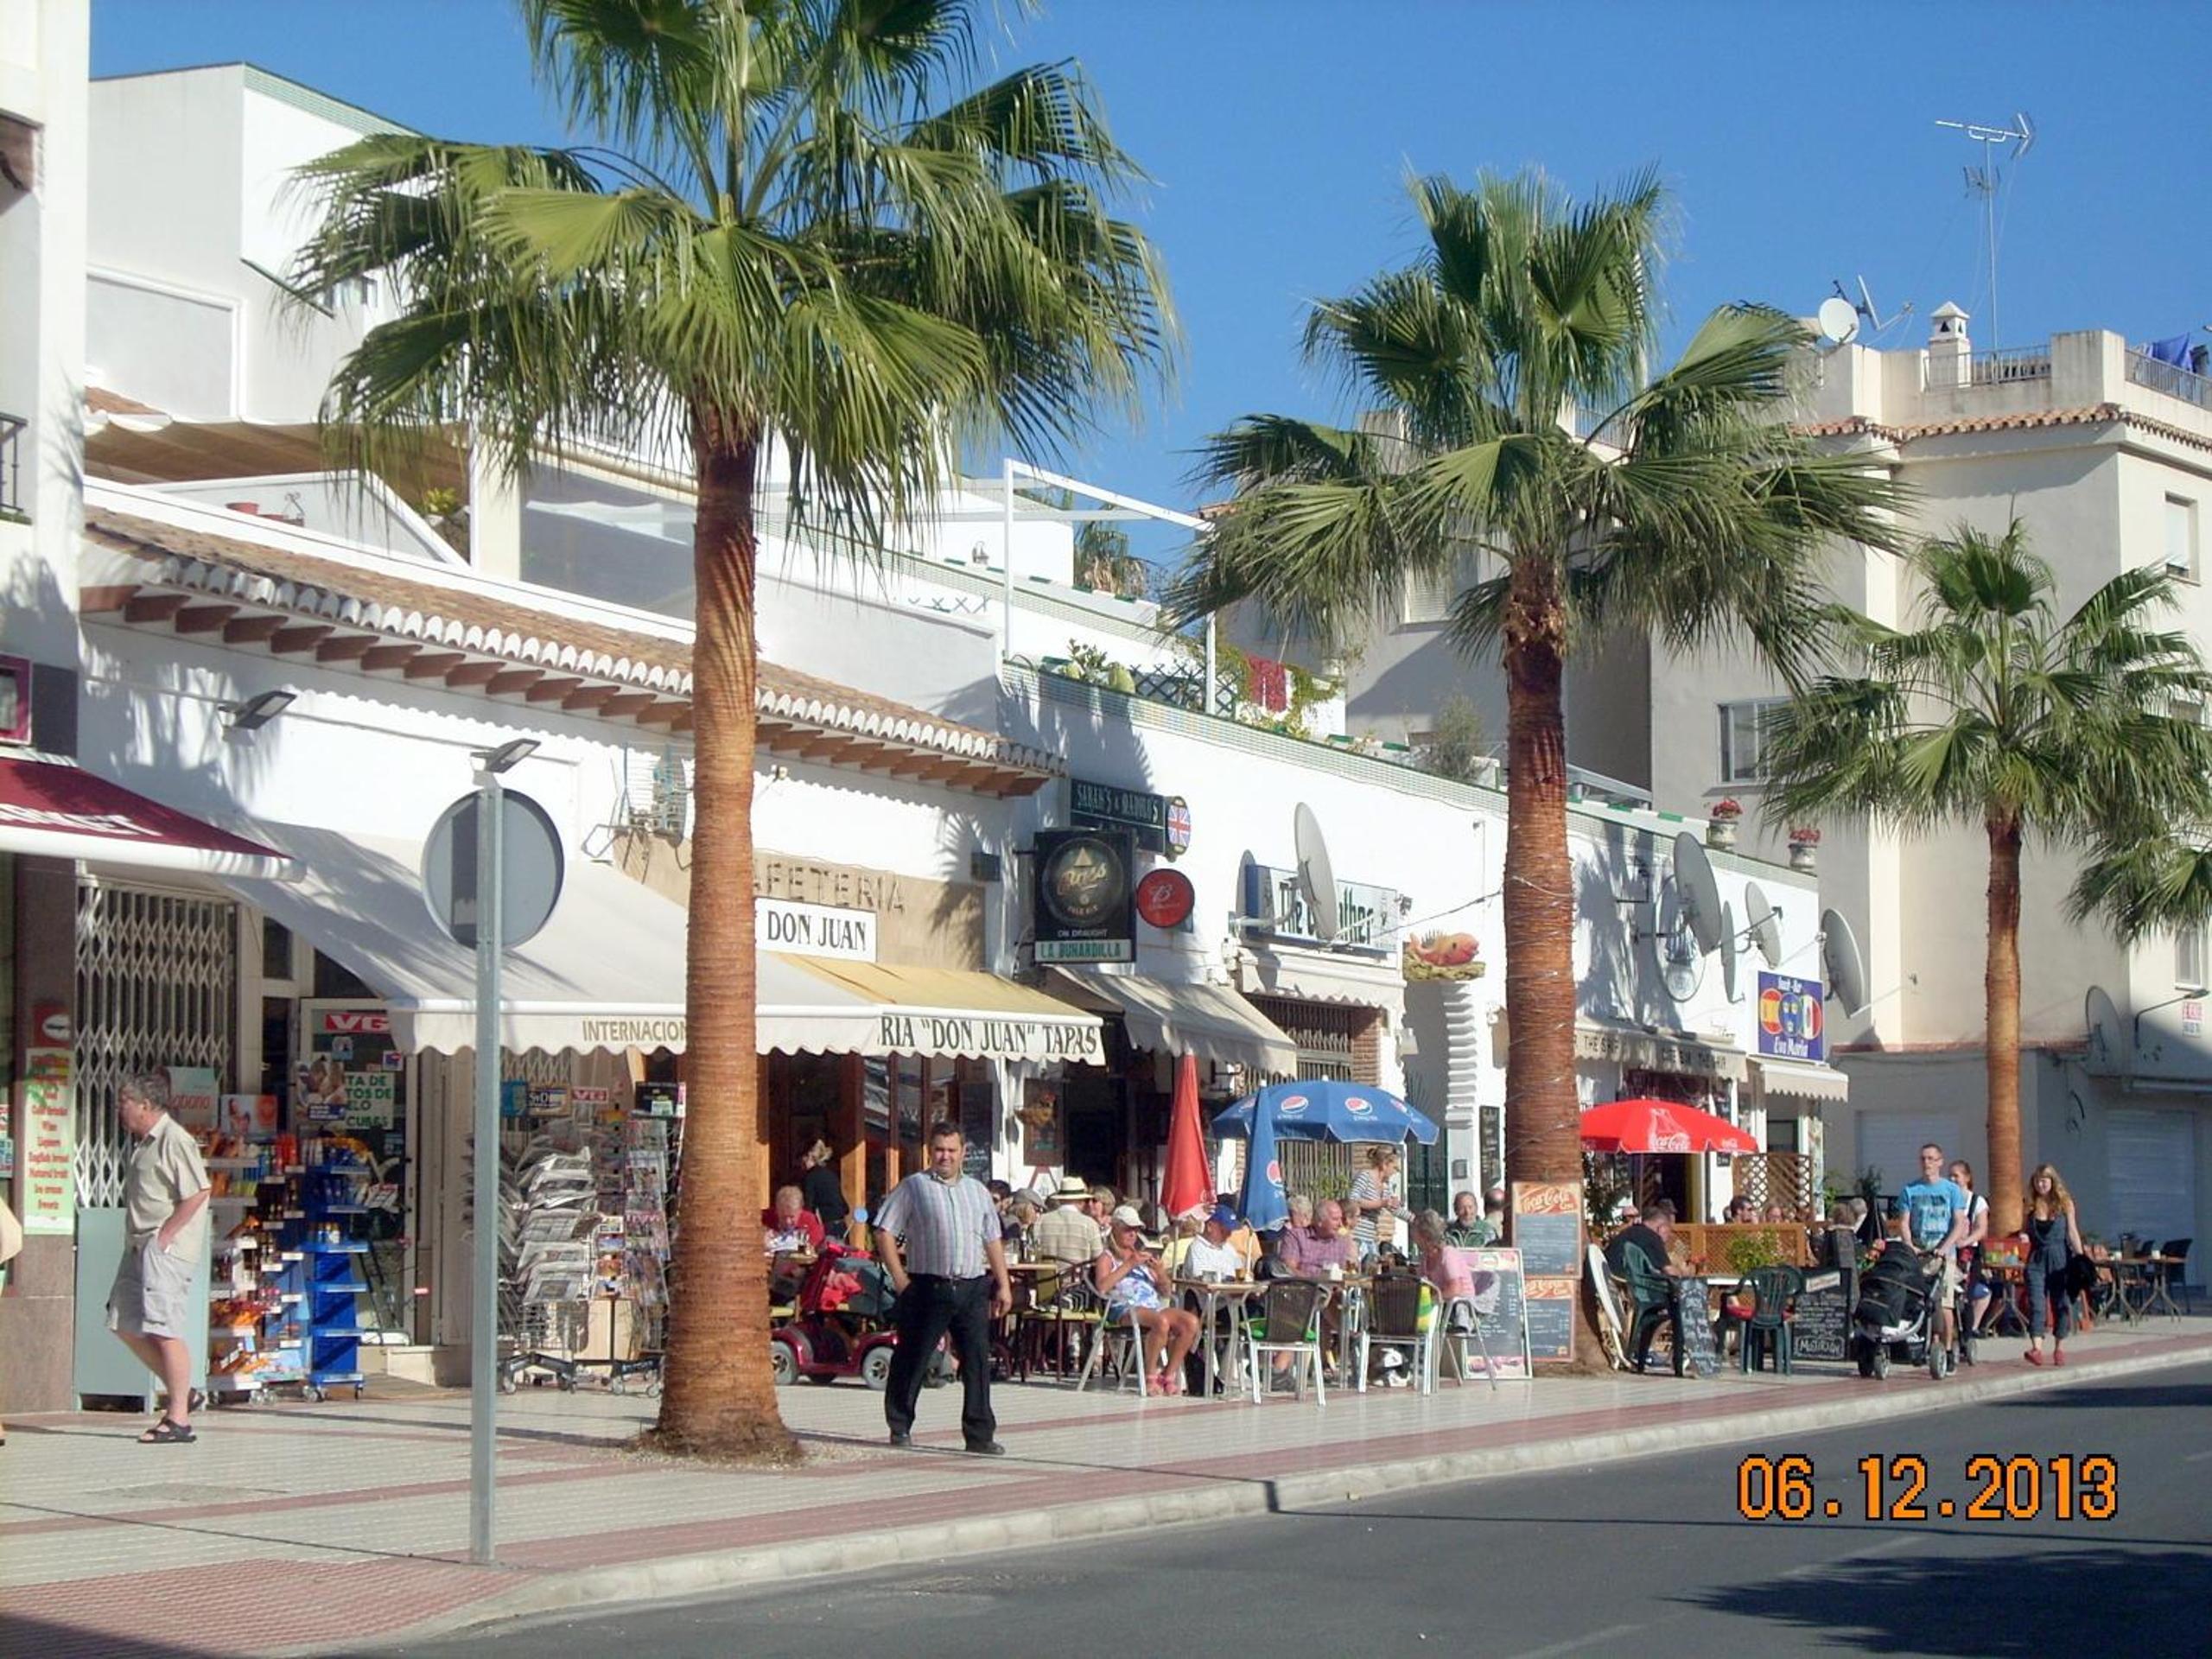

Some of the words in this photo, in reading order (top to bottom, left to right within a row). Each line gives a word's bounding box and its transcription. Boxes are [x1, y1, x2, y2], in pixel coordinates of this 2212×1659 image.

[753, 862, 906, 913] FETERIA
[767, 910, 811, 944] DON
[817, 917, 867, 951] JUAN
[1040, 943, 1055, 959] LA
[329, 1015, 389, 1032] VG
[582, 1020, 687, 1042] INTERNACION
[878, 1015, 916, 1047] RIA
[1042, 1025, 1097, 1055] TAPAS
[347, 1075, 365, 1086] TA
[370, 1075, 387, 1086] DE
[346, 1088, 372, 1099] TOS
[375, 1088, 392, 1099] DE
